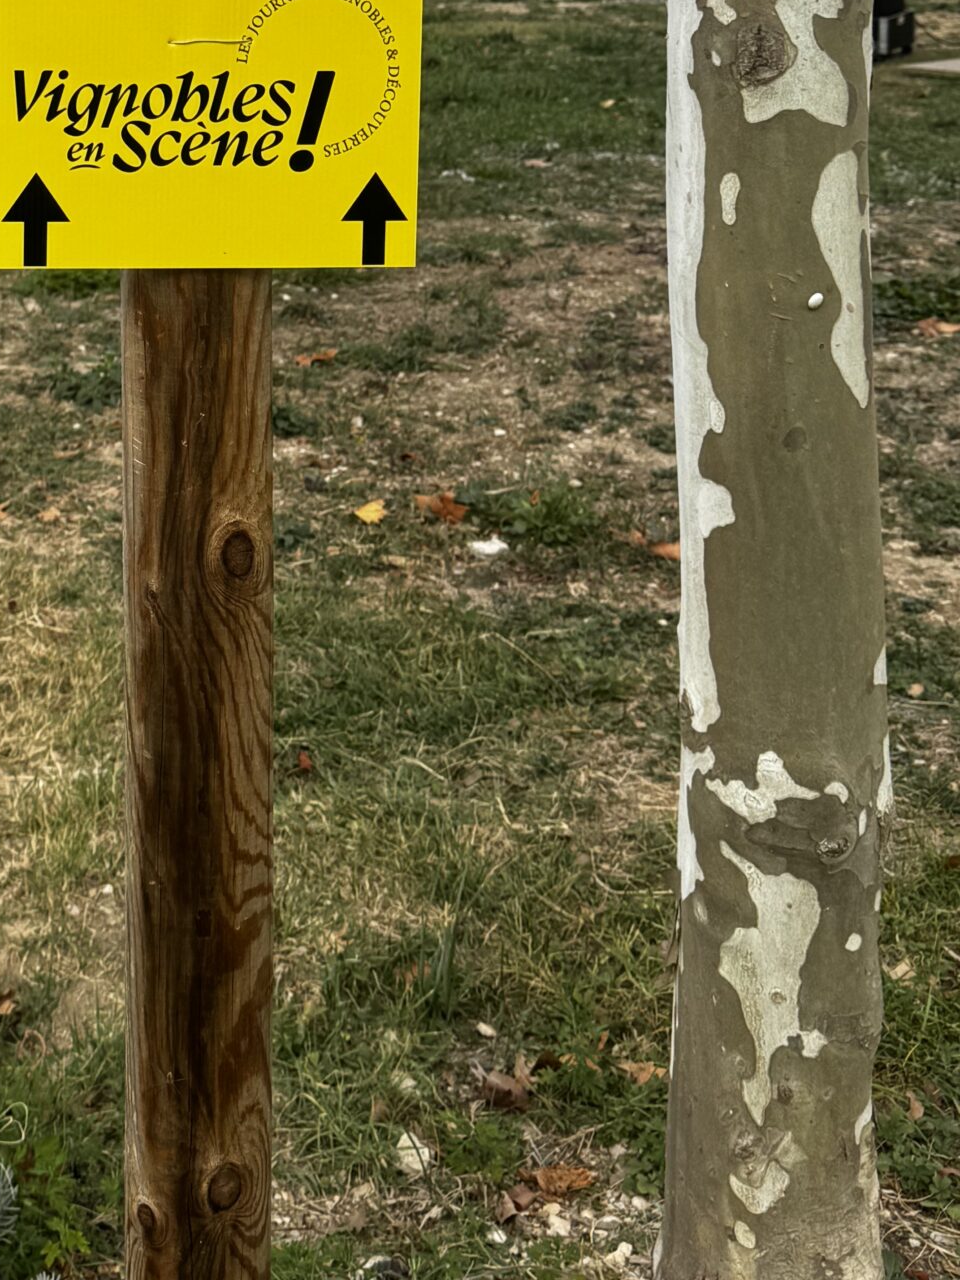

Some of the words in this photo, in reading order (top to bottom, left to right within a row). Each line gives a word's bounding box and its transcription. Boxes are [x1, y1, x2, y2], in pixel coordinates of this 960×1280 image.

[235, 35, 254, 65] LES
[385, 47, 400, 61] &
[14, 69, 296, 137] Vignobles
[323, 65, 402, 158] DÉCOUVERTES
[66, 142, 105, 168] en
